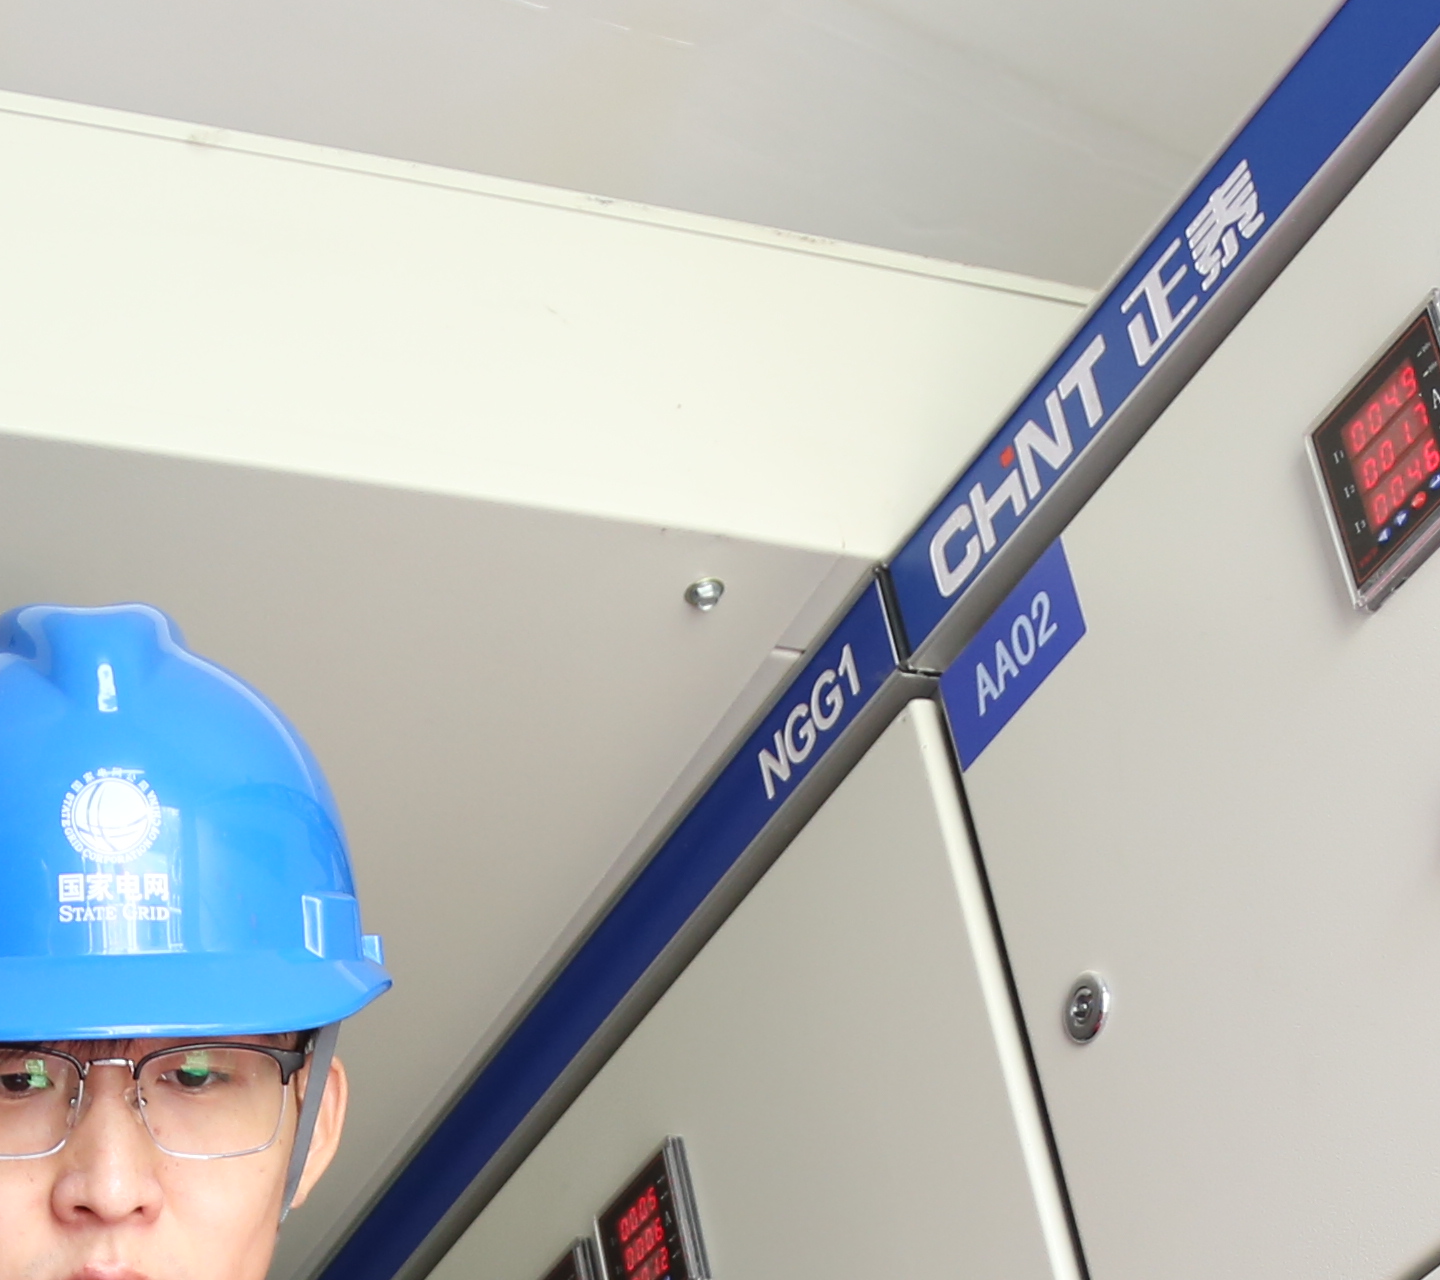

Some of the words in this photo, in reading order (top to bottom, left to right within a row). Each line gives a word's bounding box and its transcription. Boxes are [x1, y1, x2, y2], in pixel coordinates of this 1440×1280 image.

[1121, 158, 1266, 367] 正泰
[975, 591, 1058, 716] AA02
[757, 643, 860, 799] NGG1
[58, 871, 169, 902] 国家电网
[59, 905, 117, 922] STATE
[122, 904, 170, 922] GRID
